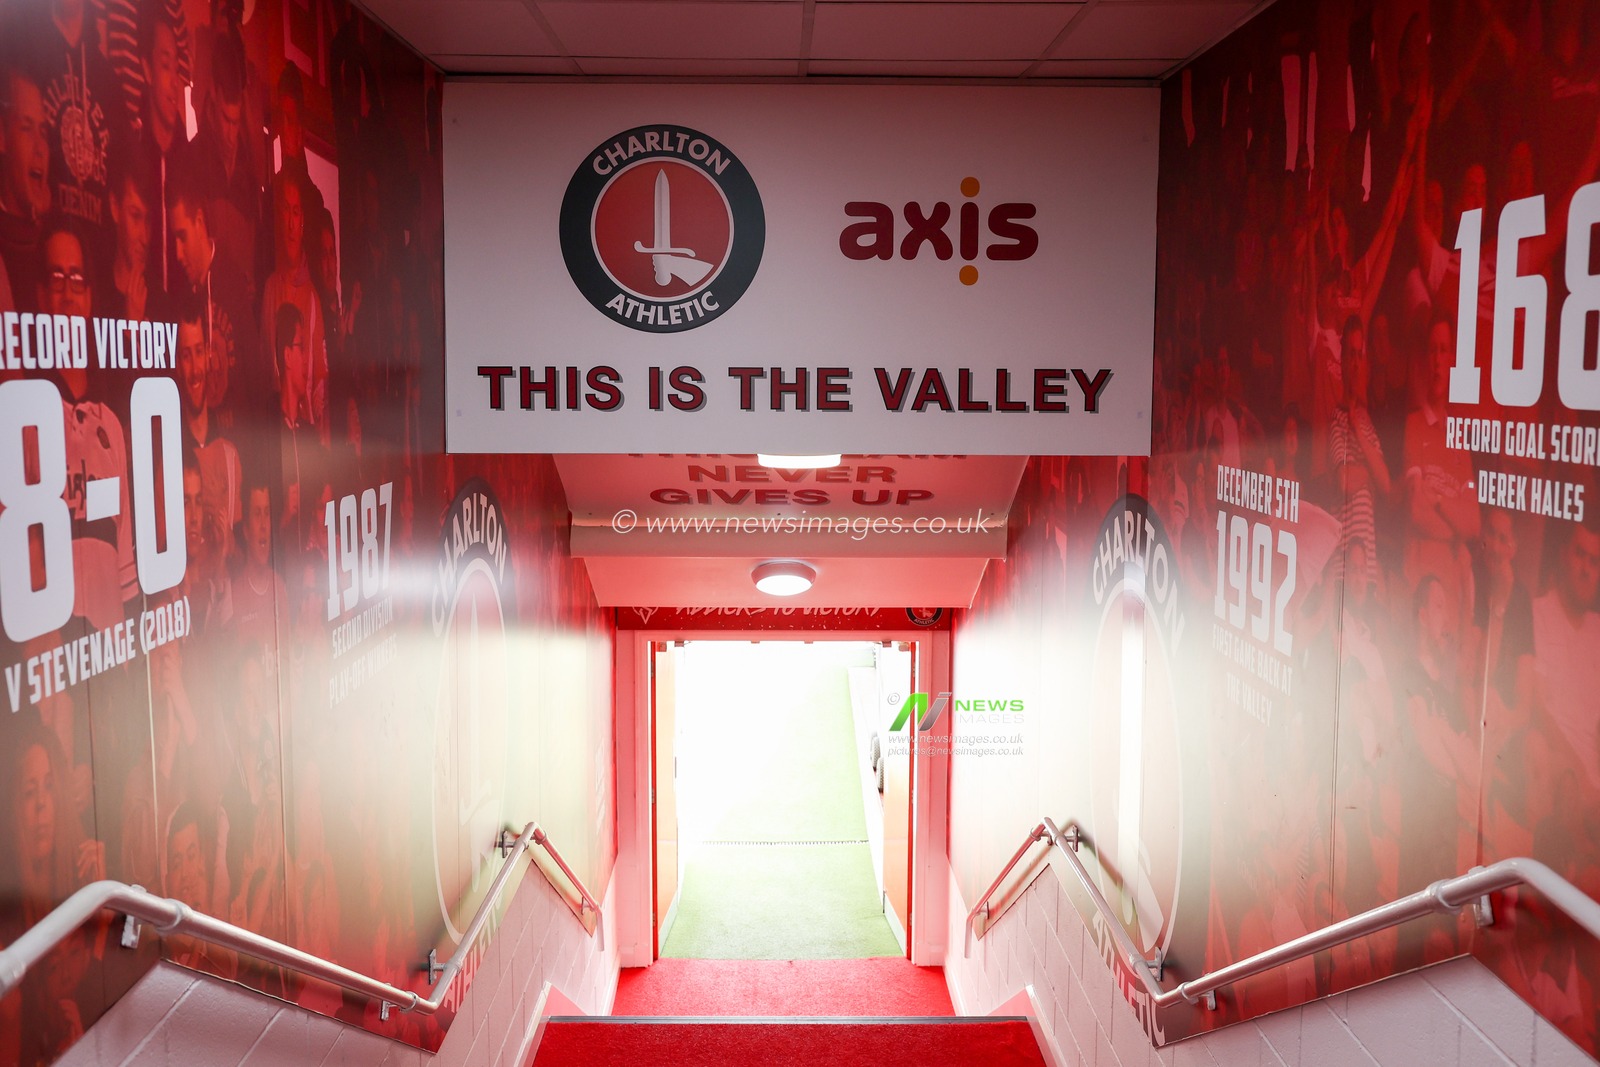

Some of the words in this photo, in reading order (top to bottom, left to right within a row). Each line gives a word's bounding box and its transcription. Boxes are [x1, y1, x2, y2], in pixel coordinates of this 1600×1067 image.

[593, 131, 731, 175] CHARLTON
[839, 176, 1038, 286] axis
[605, 291, 720, 325] ATHLETIC
[1448, 181, 1600, 411] 168
[0, 311, 88, 370] ECORD
[92, 317, 178, 369] VICTORY
[477, 366, 624, 412] THIS
[648, 366, 707, 412] IS
[728, 366, 853, 412] THE
[873, 367, 1114, 413] VALLEY
[1446, 416, 1502, 454] RECORD
[1504, 420, 1546, 460] GOAL
[1550, 424, 1600, 467] SCOR
[650, 488, 831, 505] GIVES
[852, 489, 934, 505] UP
[687, 464, 896, 483] NEVER
[1216, 464, 1273, 516] DECEMBER
[1275, 477, 1300, 524] 5TH
[1477, 469, 1527, 512] DEREK
[1530, 478, 1584, 523] HALES
[0, 376, 187, 643] 8-0
[324, 481, 393, 622] 1987
[431, 492, 507, 638] CHARLTON
[1092, 510, 1185, 655] CHARLTON
[1214, 509, 1297, 657] 1992
[5, 663, 21, 713] V
[27, 618, 136, 704] STEVENAGE
[138, 595, 191, 655] (2018)
[332, 614, 363, 659] SECOND
[363, 595, 393, 639] DIVISION
[329, 655, 366, 709] PLAY-OFF
[1212, 623, 1233, 659] FIRST
[1233, 636, 1256, 674] GAME
[1257, 649, 1280, 689] BACK
[1281, 664, 1293, 697] AT
[1242, 681, 1273, 728] VALLEY
